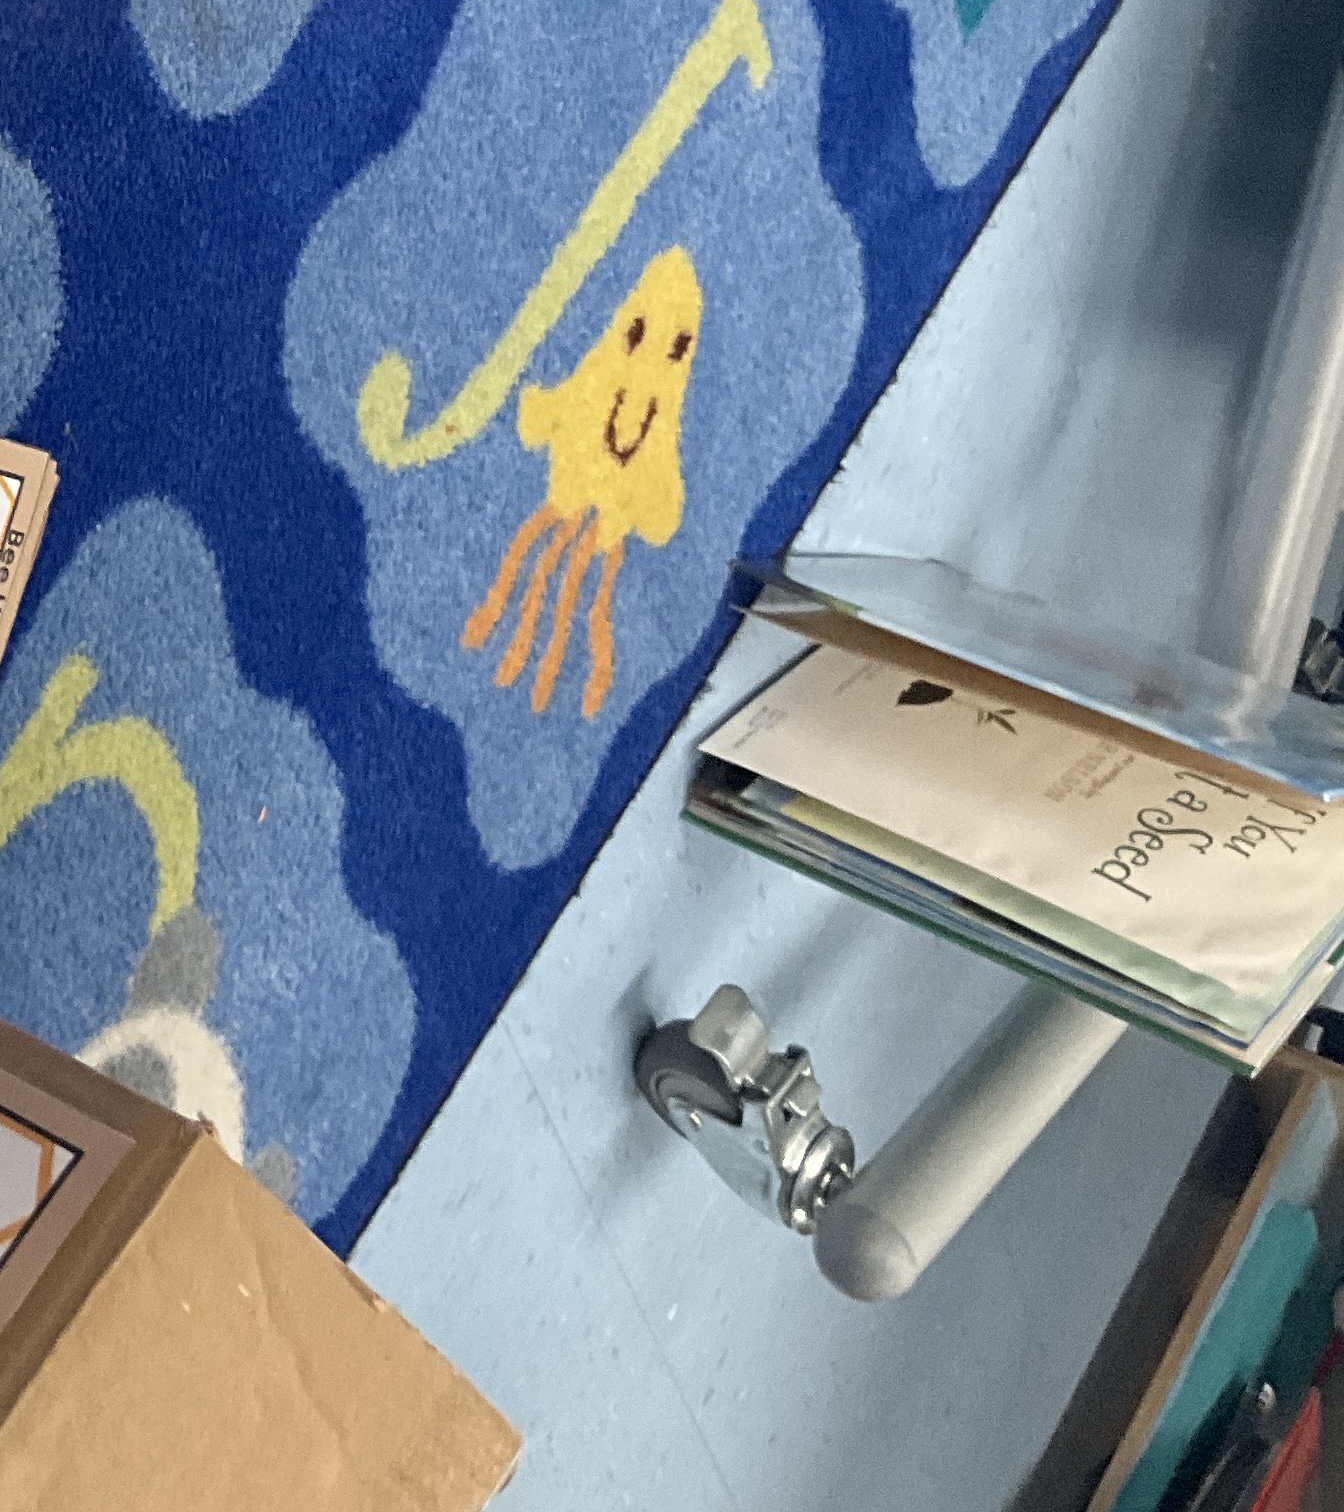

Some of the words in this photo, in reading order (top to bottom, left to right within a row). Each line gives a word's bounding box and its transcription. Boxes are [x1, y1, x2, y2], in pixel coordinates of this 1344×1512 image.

[1167, 789, 1208, 813] a
[1091, 806, 1214, 902] Seed
[1223, 815, 1308, 859] You
